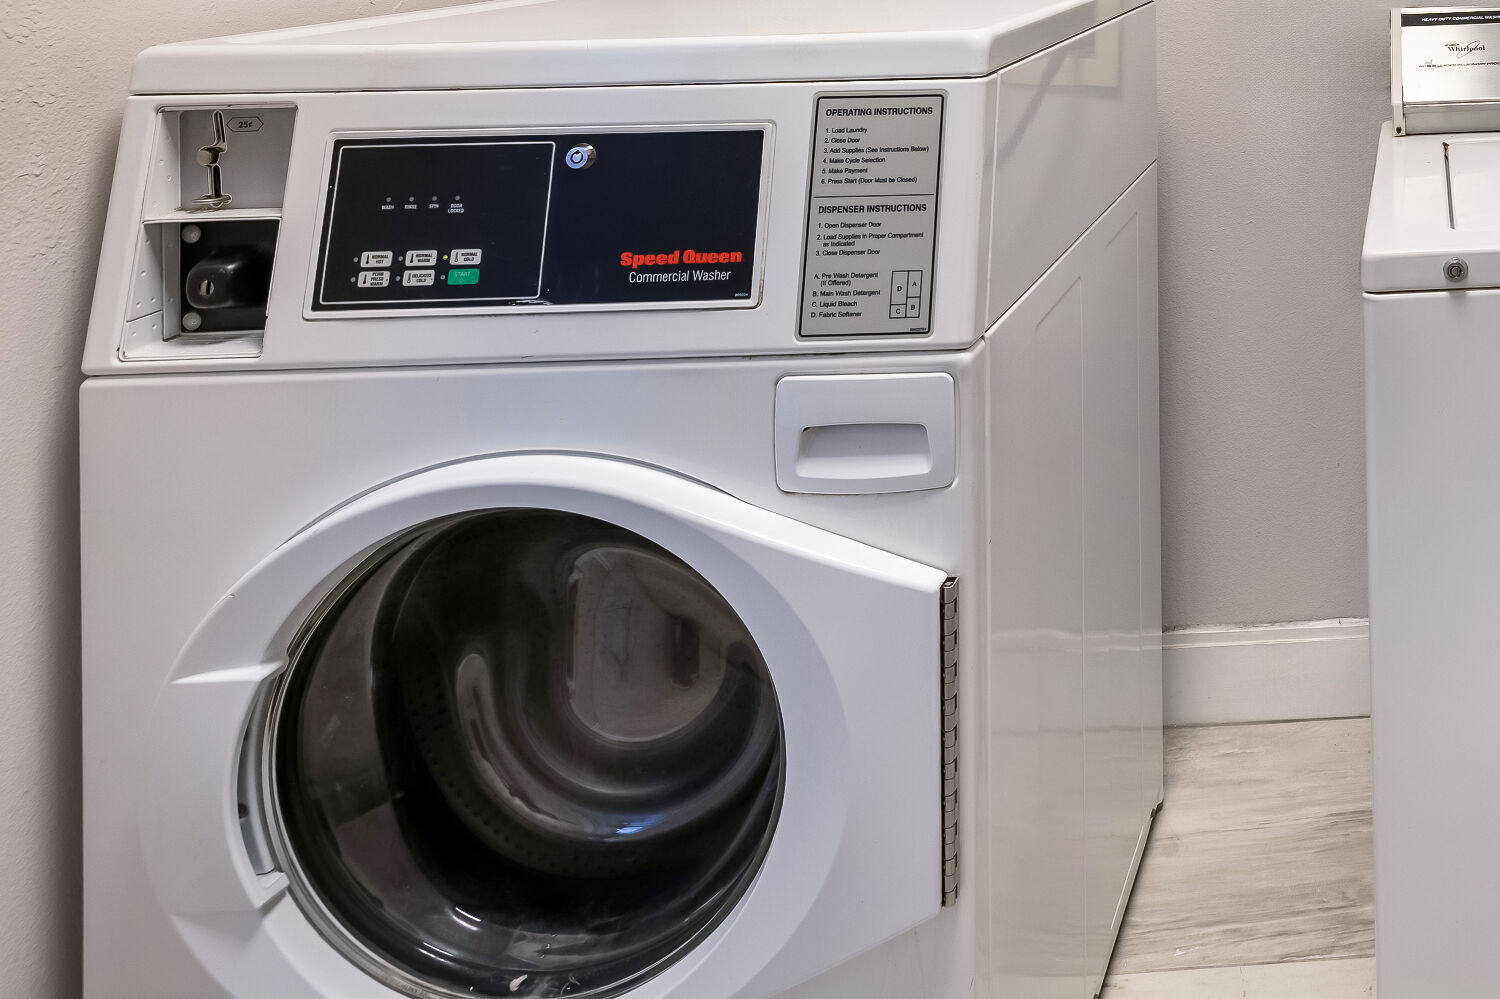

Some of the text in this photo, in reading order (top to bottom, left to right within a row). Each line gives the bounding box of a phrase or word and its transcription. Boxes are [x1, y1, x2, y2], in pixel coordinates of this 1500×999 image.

[874, 107, 932, 116] INSTRUCTIONS
[819, 204, 926, 214] DISPENSER INSTRUCTIONS
[620, 249, 743, 269] Speed Queen
[629, 269, 731, 283] Commercial Washer
